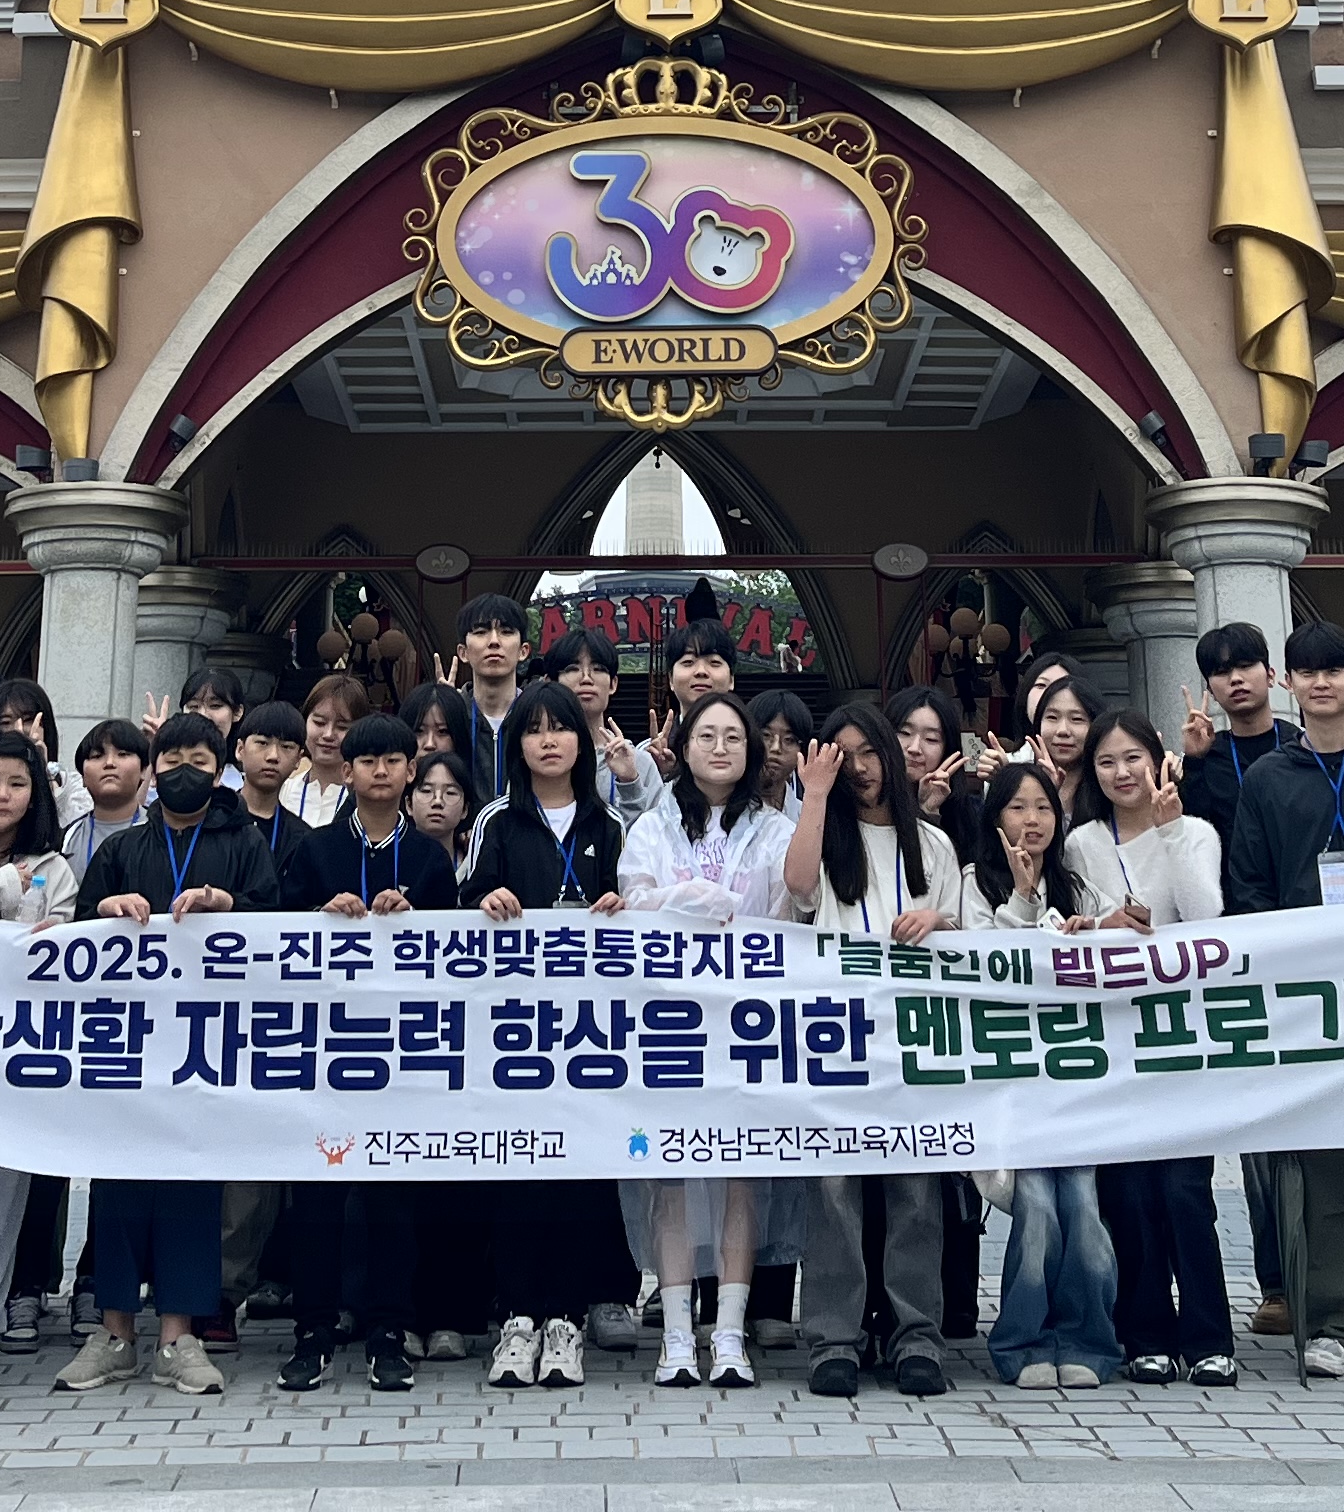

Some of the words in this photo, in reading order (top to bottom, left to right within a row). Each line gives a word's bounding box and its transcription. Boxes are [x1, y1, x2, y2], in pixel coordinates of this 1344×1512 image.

[545, 149, 796, 322] 30
[538, 595, 818, 667] ARNIVAL
[27, 933, 182, 982] 2025.
[201, 931, 374, 981] 온-진주
[392, 926, 785, 980] 학생맞춤통합지원
[172, 999, 466, 1091] 자립능력
[490, 998, 707, 1089] 향상을
[730, 996, 875, 1086] 위한
[894, 995, 1109, 1085] 멘토링
[364, 1128, 567, 1166] 진주교육대학교
[659, 1124, 976, 1163] 경상남도진주교육지원청
